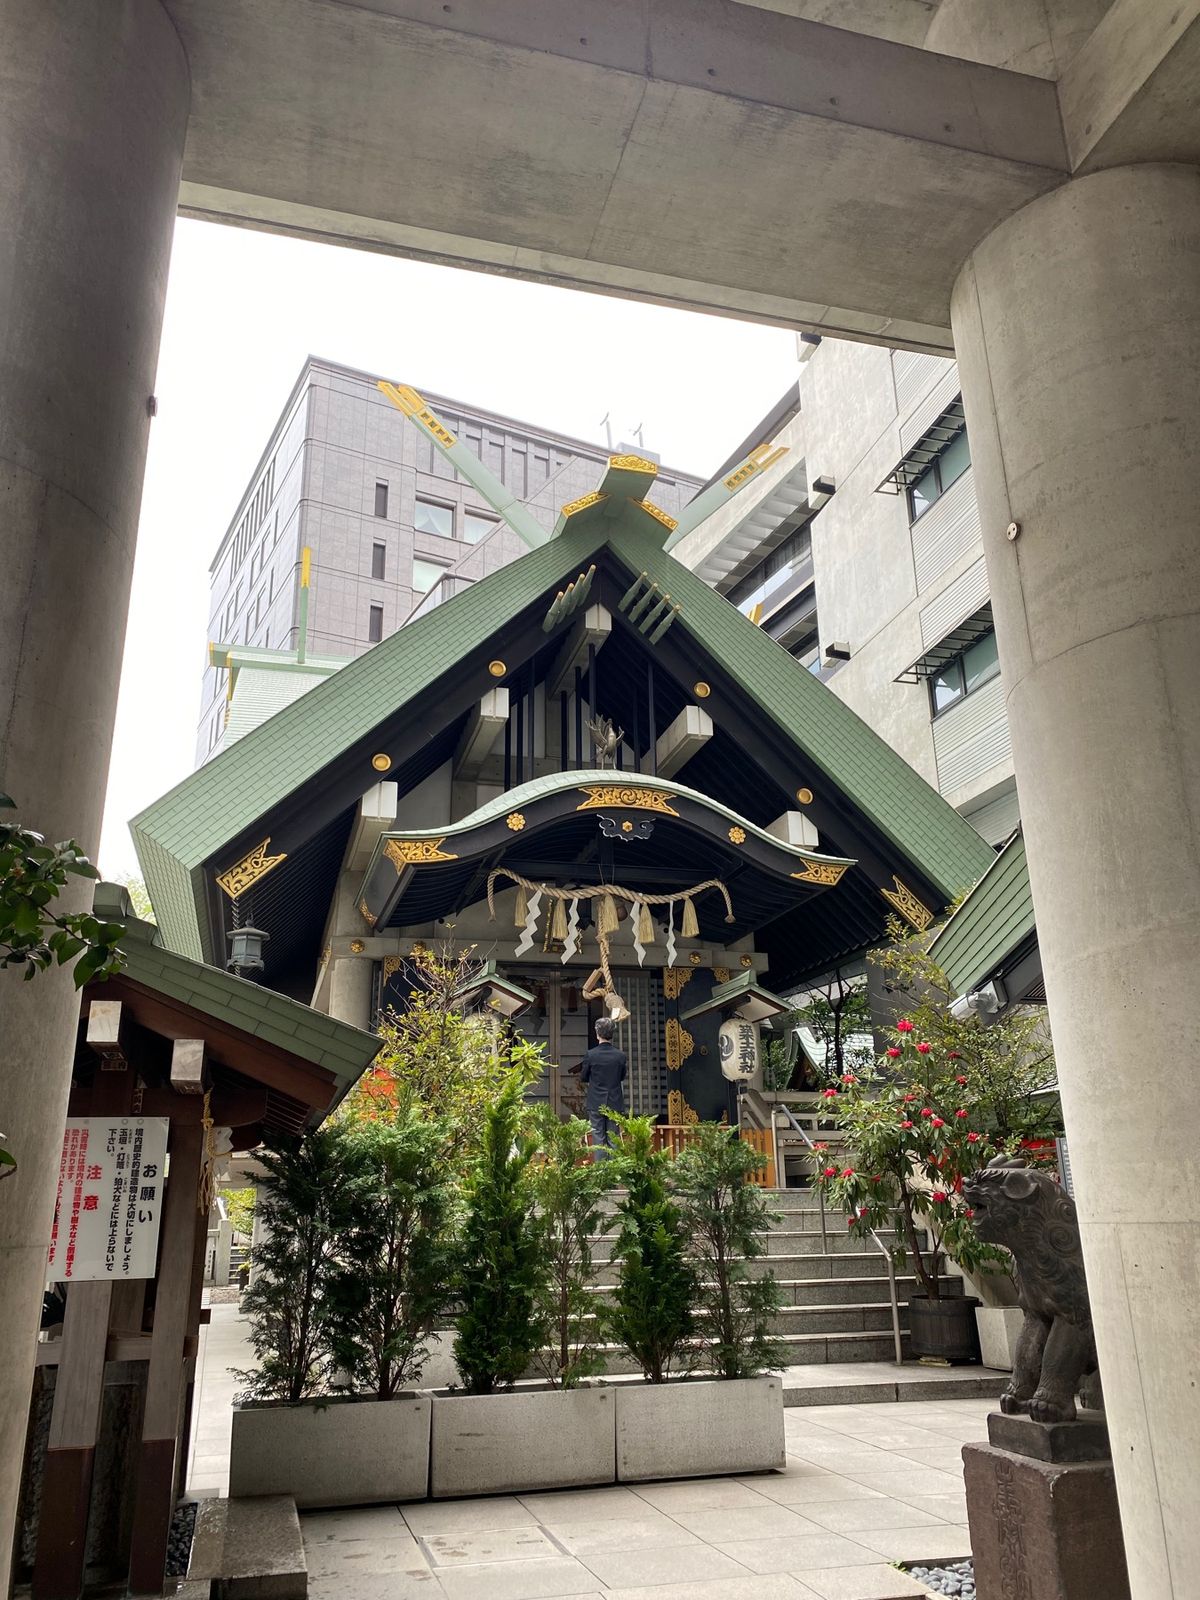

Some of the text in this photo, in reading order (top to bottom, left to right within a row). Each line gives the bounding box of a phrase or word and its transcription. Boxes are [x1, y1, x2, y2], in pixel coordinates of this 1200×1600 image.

[738, 1024, 755, 1073] 築土神社
[106, 1128, 117, 1157] 下さい。
[83, 1165, 102, 1211] 注意
[138, 1164, 157, 1223] お願い
